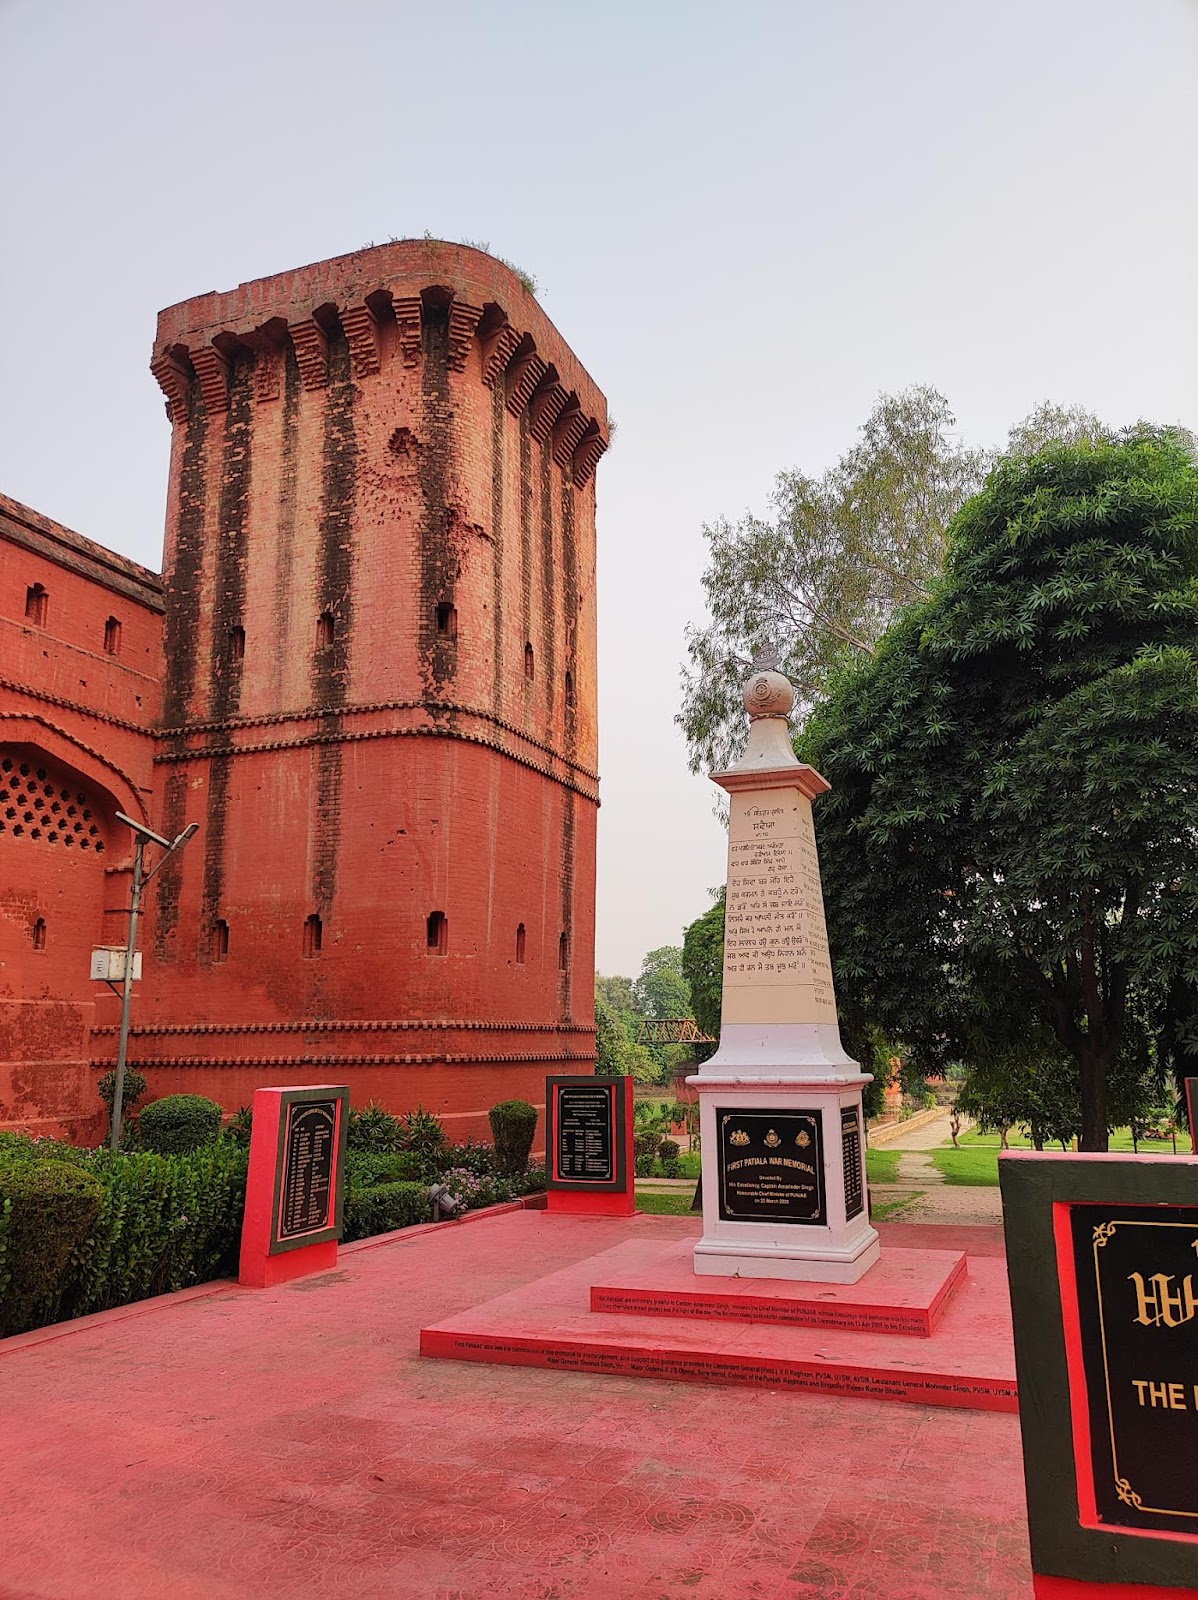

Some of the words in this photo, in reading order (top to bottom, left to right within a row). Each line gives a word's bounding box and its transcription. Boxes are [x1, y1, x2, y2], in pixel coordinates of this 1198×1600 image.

[732, 879, 740, 887] ਦੇਹ
[760, 888, 765, 897] ਤੇ
[783, 924, 794, 932] ਮਨ
[727, 952, 736, 960] ਜਬ
[752, 950, 759, 958] ਕੀ
[739, 963, 745, 972] ਹੀ
[764, 963, 774, 971] ਤਬ
[727, 1159, 744, 1172] FIRST
[744, 1157, 768, 1167] PATIALA
[768, 1156, 783, 1166] WAR
[783, 1157, 816, 1176] MEMORIAL
[705, 1361, 713, 1369] by
[740, 1364, 760, 1373] General
[865, 1385, 884, 1394] Kumar
[1131, 1380, 1187, 1410] THE
